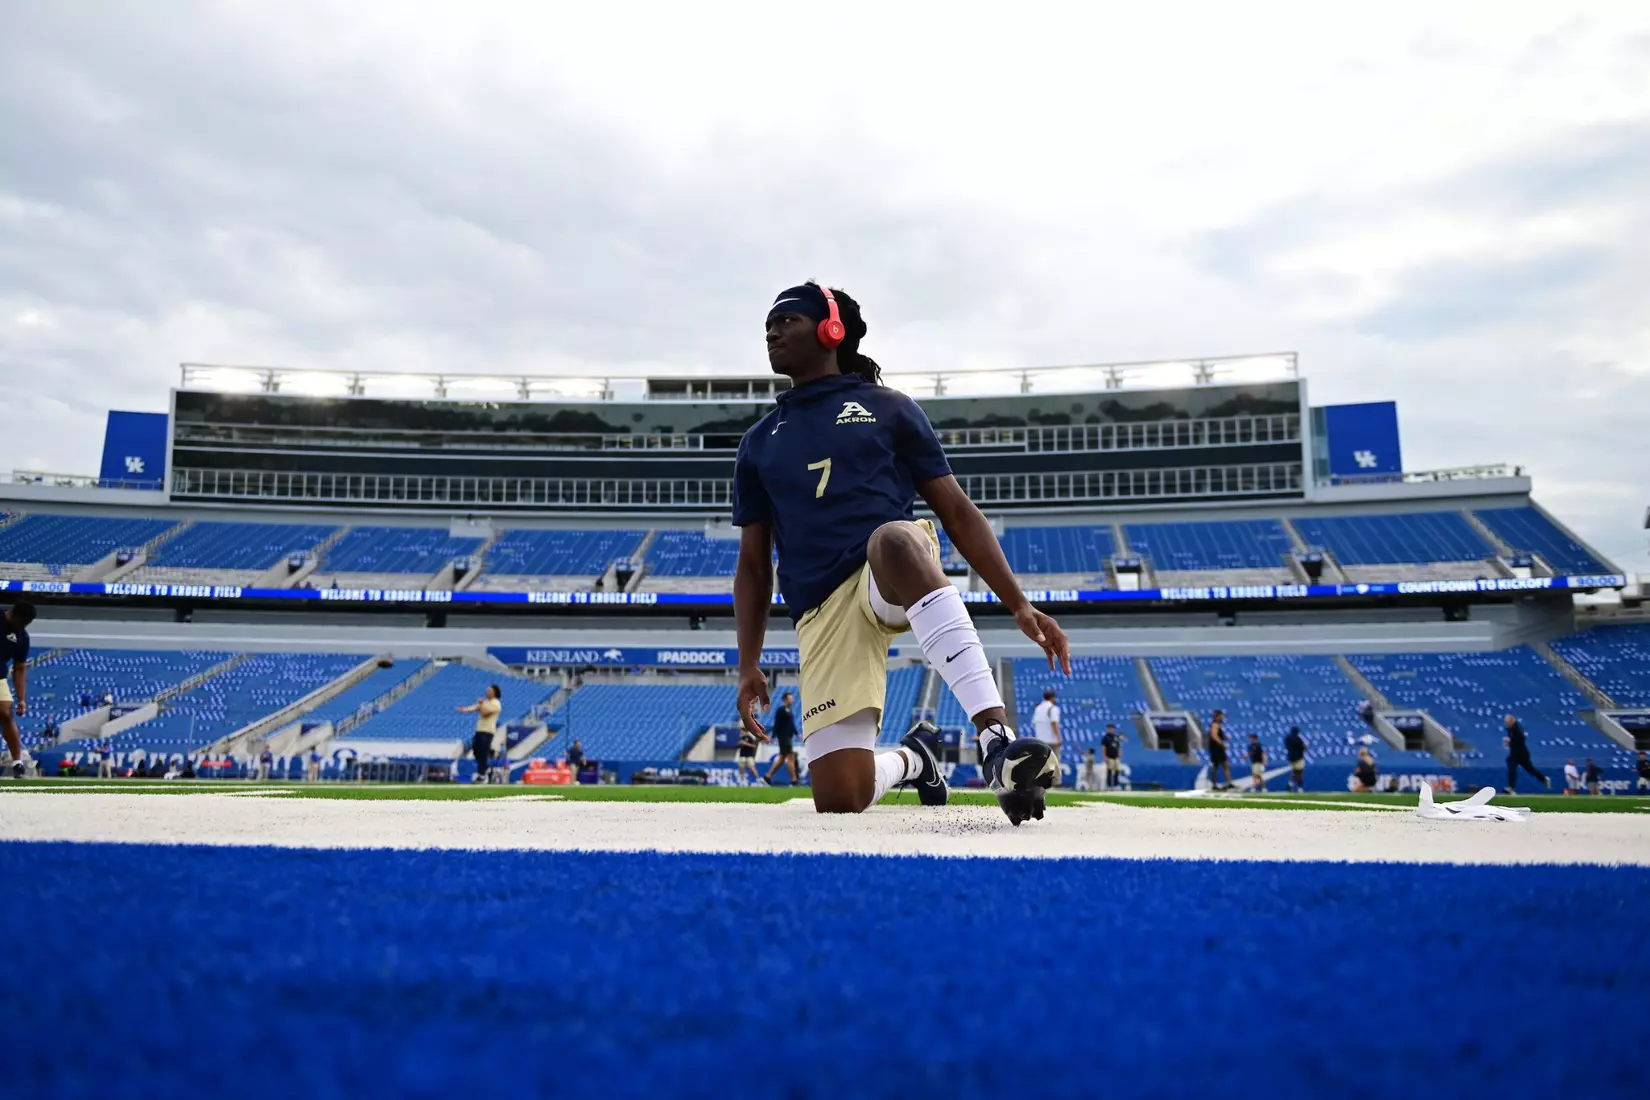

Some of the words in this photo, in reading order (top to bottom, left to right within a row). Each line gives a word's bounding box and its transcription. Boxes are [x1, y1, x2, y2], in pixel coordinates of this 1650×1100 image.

[836, 416, 877, 425] AKRON
[808, 458, 832, 499] 7
[105, 583, 152, 595] WELCOME
[155, 585, 168, 596] TO
[214, 586, 242, 598] FIELD
[1397, 580, 1477, 593] COUNTDOWN
[1479, 579, 1495, 591] TO
[1498, 577, 1553, 590] KICKOFF
[320, 589, 365, 600] WELCOME
[368, 590, 381, 601] TO
[527, 592, 572, 603] WELCOME
[575, 592, 587, 603] TO
[630, 592, 657, 604] FIELD
[1212, 587, 1227, 598] TO
[526, 649, 600, 662] KEENELAND
[662, 651, 726, 664] PADDOCK
